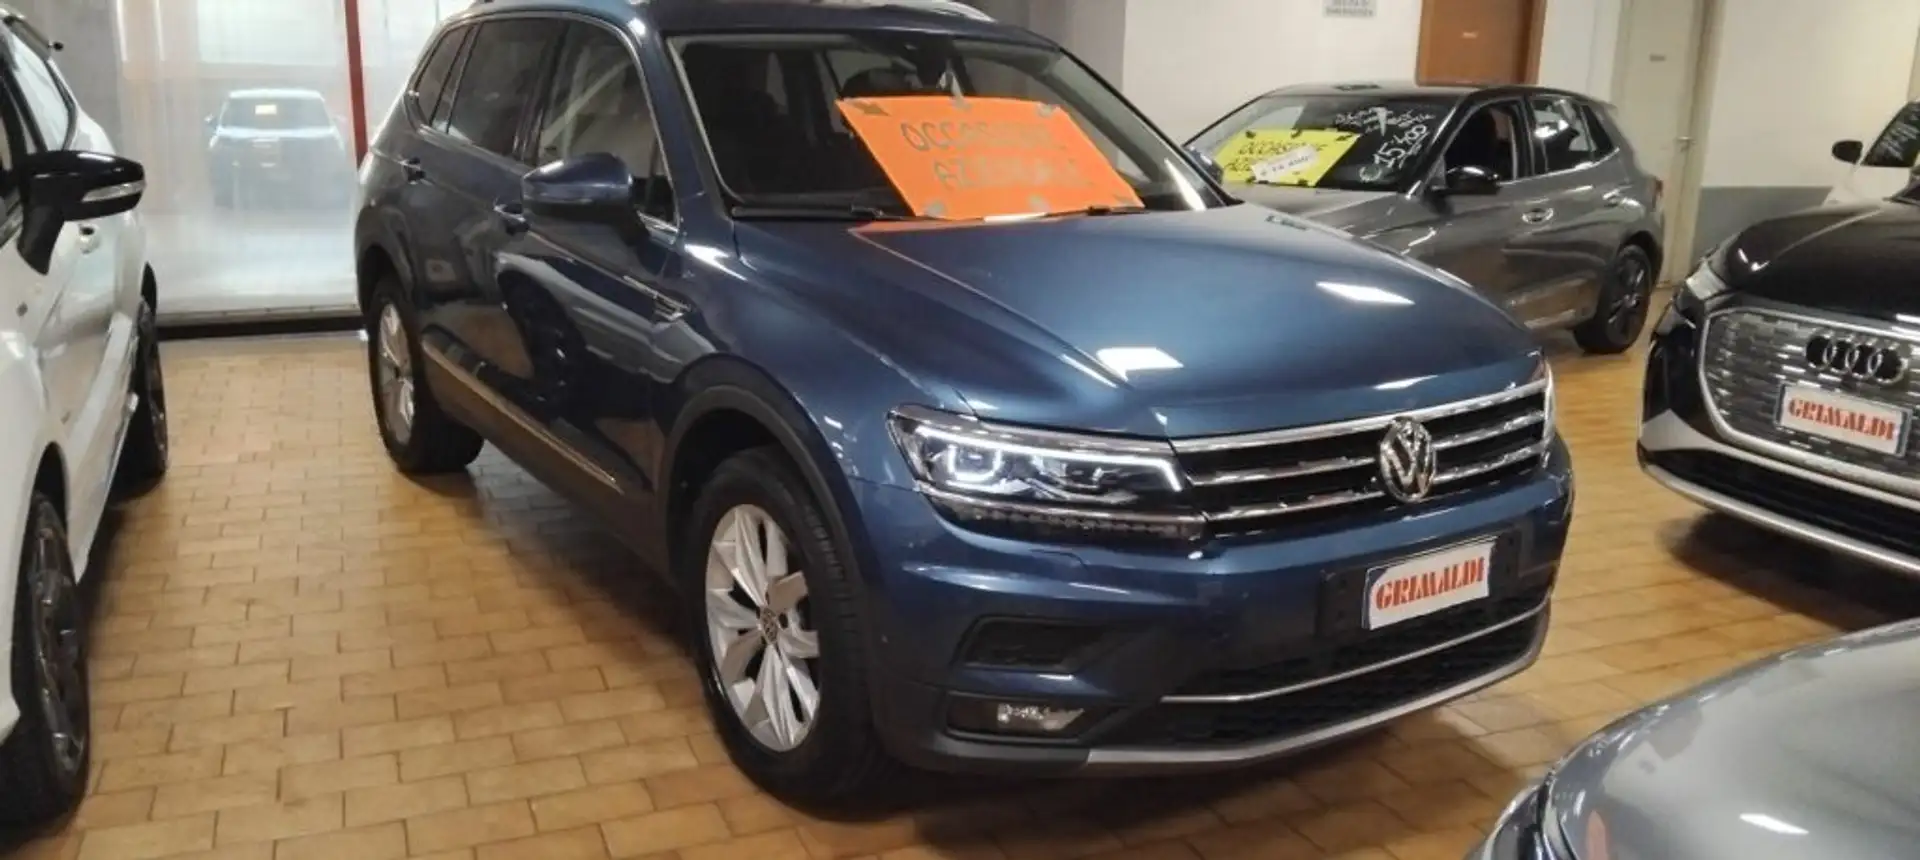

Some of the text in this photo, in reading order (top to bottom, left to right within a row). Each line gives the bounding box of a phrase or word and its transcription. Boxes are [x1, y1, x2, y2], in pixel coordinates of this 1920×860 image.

[901, 121, 1068, 151] OCCAS
[1789, 397, 1896, 442] GRIMALDI
[1376, 556, 1485, 611] GRIMALDI
